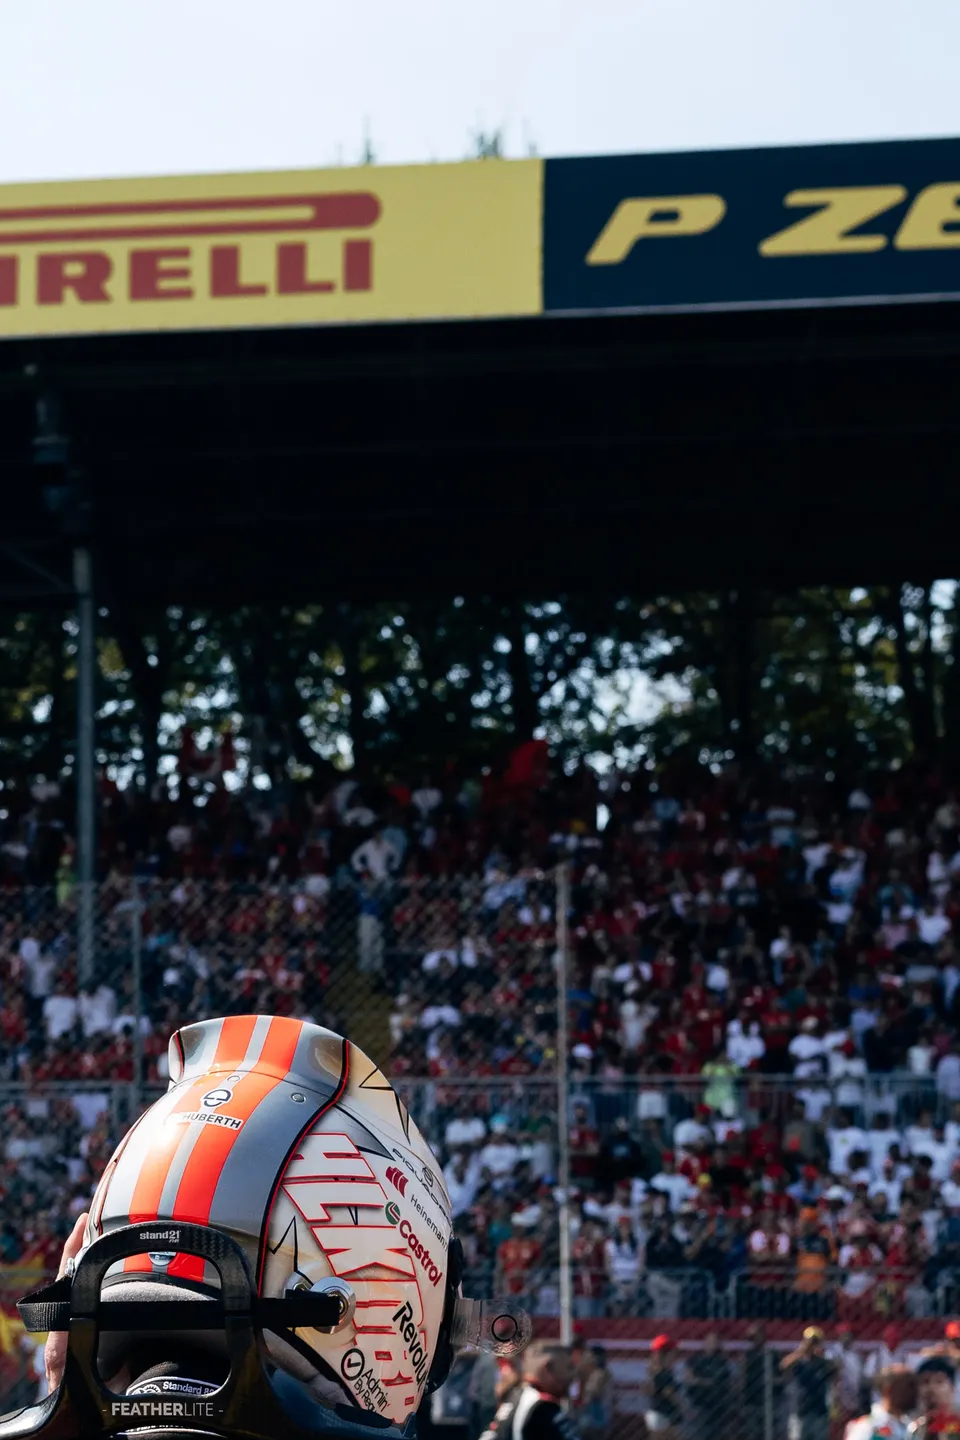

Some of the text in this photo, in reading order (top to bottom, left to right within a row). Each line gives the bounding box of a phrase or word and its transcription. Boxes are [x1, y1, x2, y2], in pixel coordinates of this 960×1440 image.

[584, 193, 728, 266] P
[182, 1112, 243, 1130] HUBERTH
[139, 1230, 180, 1240] stand21
[399, 1219, 443, 1288] Castrol
[162, 1380, 203, 1395] Standard
[111, 1402, 214, 1417] FEATHERLITE
